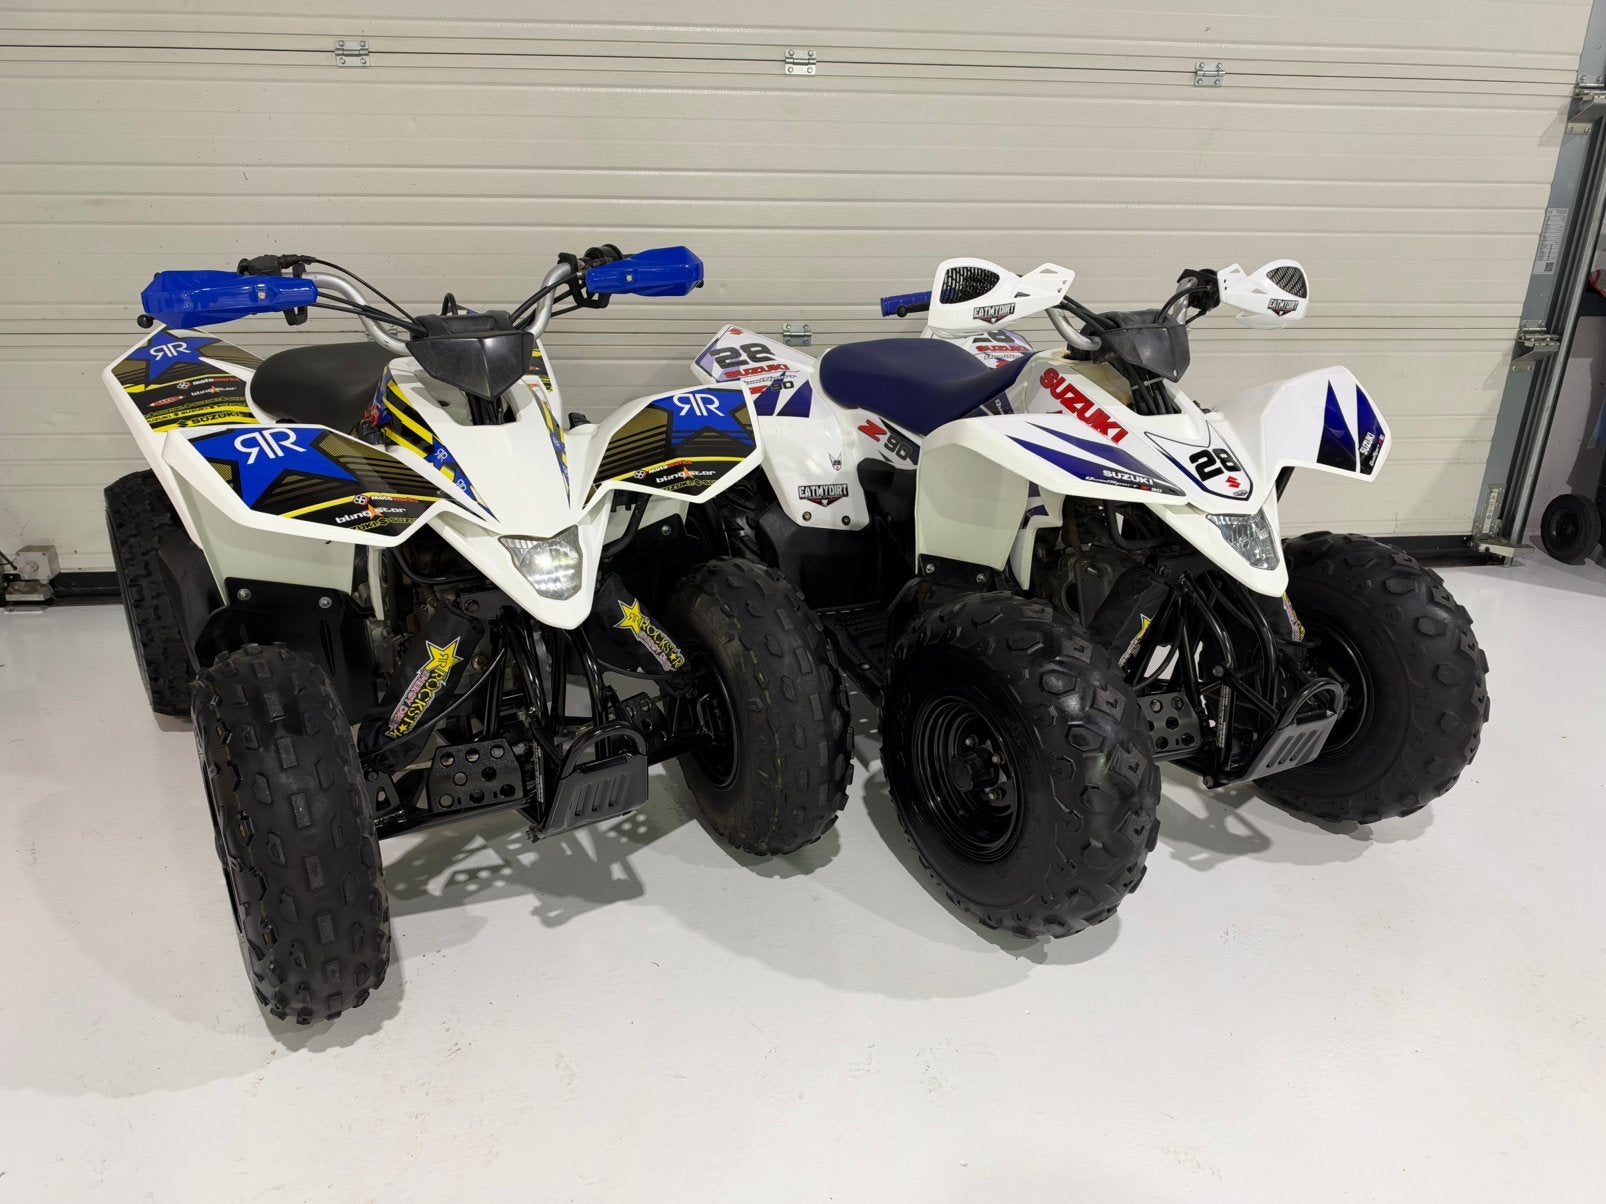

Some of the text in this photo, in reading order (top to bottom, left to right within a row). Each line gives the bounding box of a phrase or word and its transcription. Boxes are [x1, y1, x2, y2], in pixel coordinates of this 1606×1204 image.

[973, 303, 1015, 319] EATMYDIRT
[710, 343, 776, 369] 28
[724, 364, 790, 378] SUZUKI
[1040, 368, 1129, 444] SUZUKI
[191, 411, 243, 424] SUZUKI
[1360, 432, 1375, 455] SUZUKI
[1189, 448, 1241, 481] 28
[1102, 470, 1154, 485] SUZUKI
[799, 484, 848, 499] EATMYDIRT
